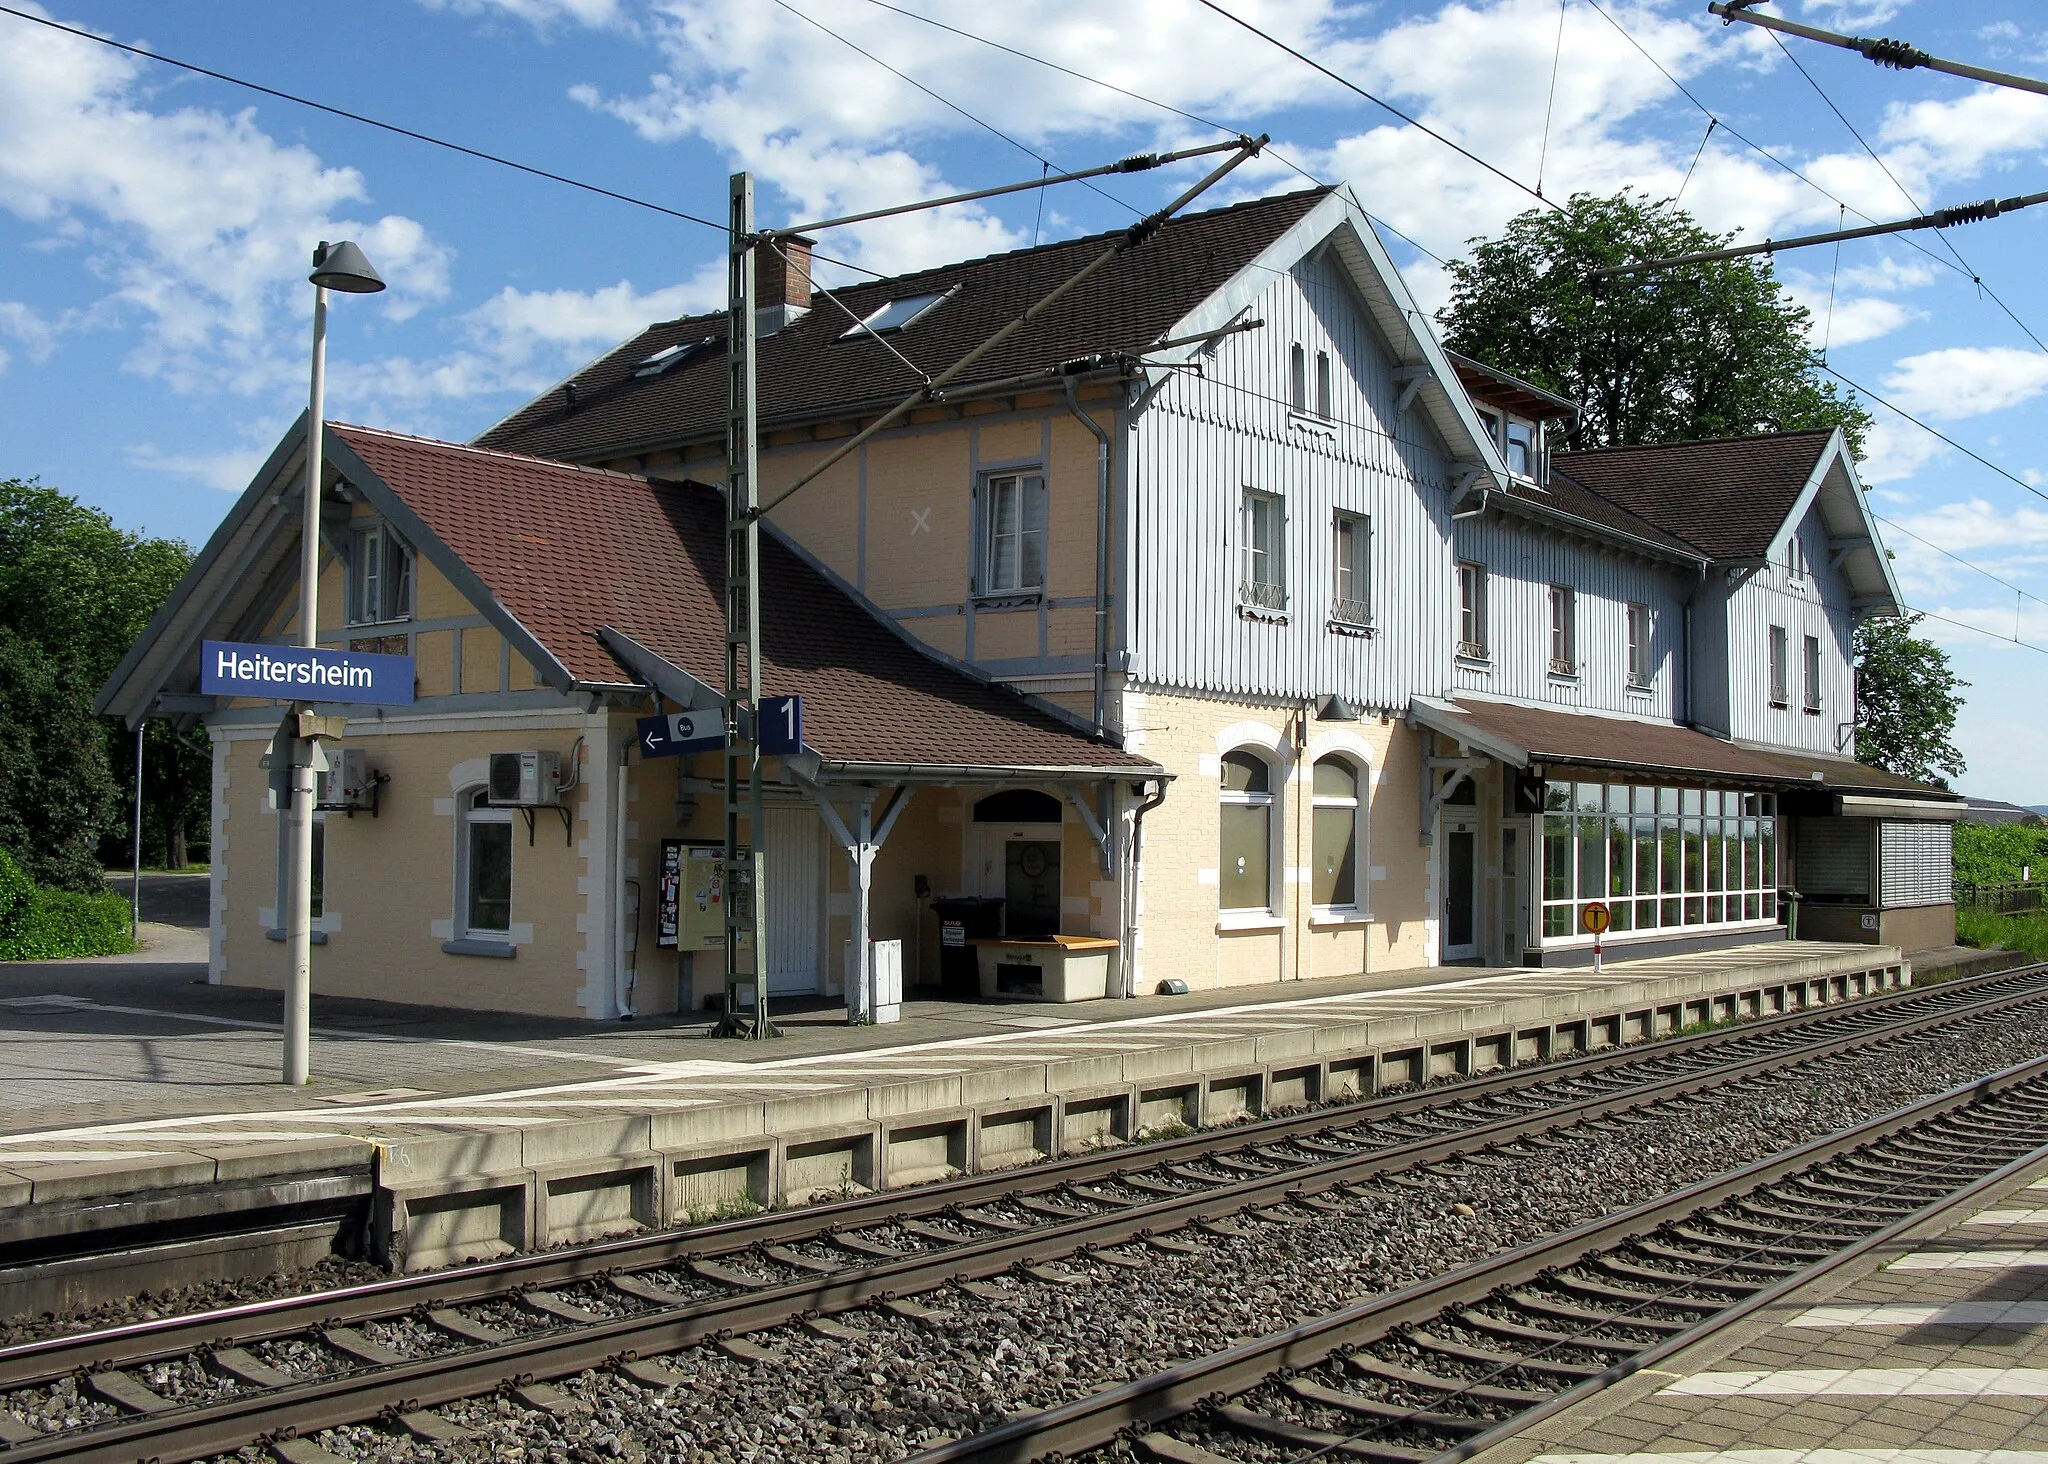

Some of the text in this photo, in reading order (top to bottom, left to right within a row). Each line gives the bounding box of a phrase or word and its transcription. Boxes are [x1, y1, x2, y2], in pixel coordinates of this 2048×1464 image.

[217, 650, 373, 688] Heitersheim
[679, 724, 692, 732] Bus
[781, 698, 794, 740] 1
